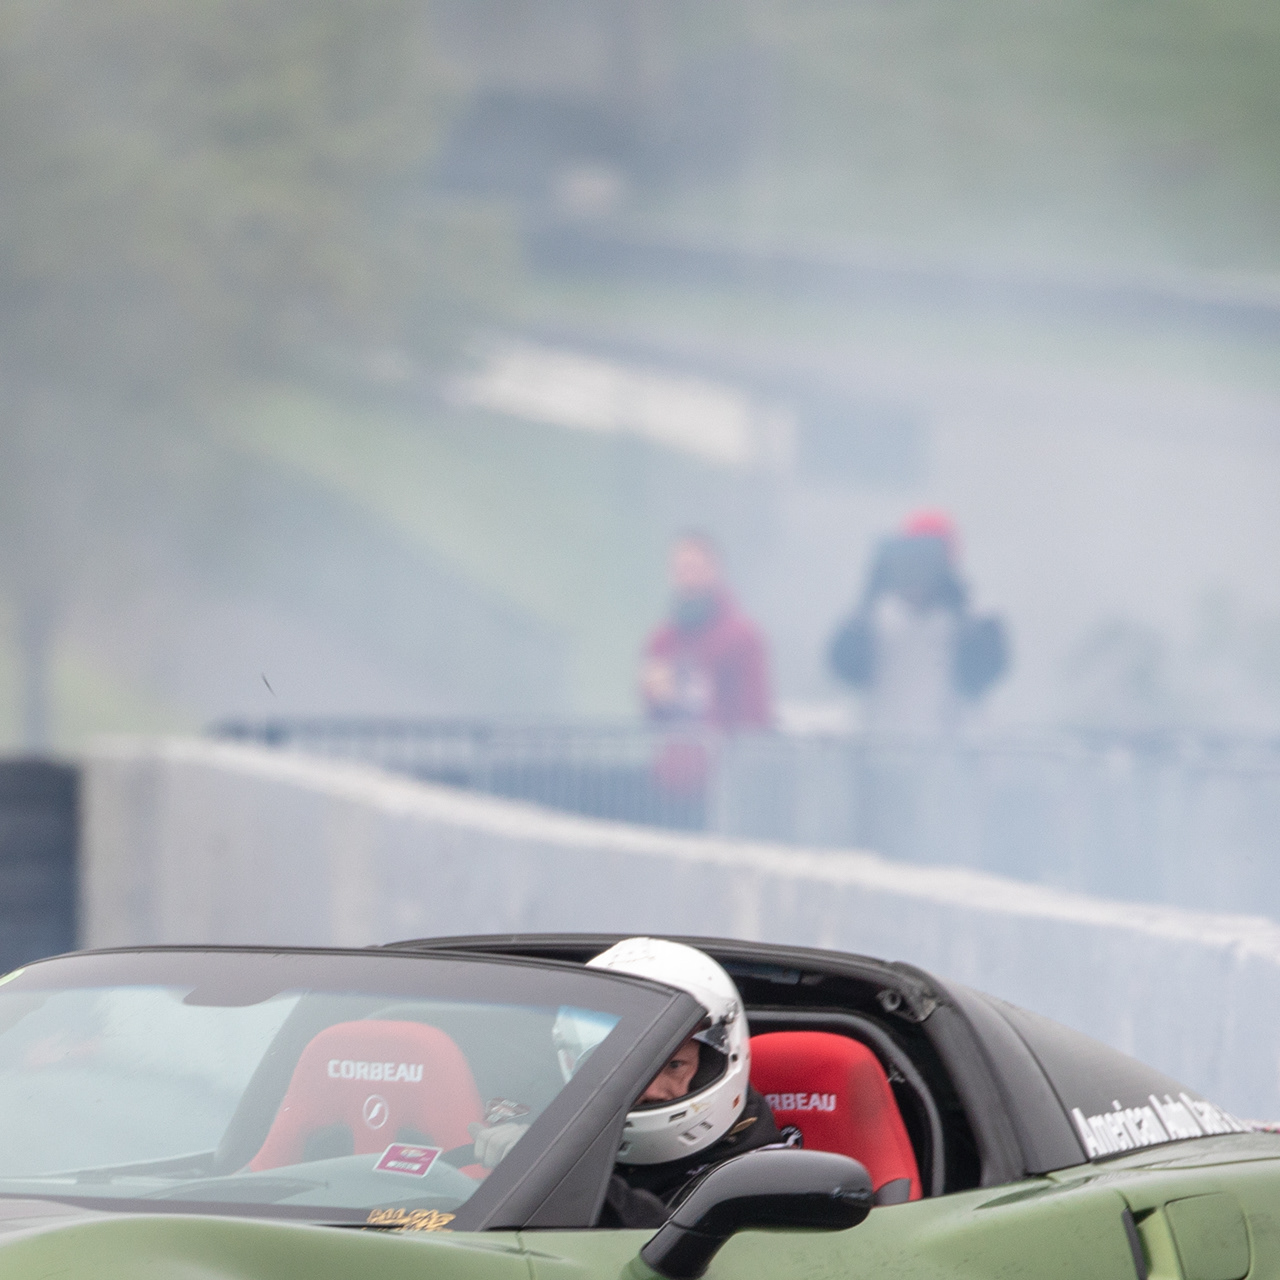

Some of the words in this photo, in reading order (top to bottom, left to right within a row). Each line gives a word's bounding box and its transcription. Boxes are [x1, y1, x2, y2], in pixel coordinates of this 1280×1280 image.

[327, 1059, 424, 1082] CORBEAU
[765, 1092, 837, 1111] RBEAU
[1071, 1100, 1169, 1158] American
[1148, 1094, 1204, 1140] Auto
